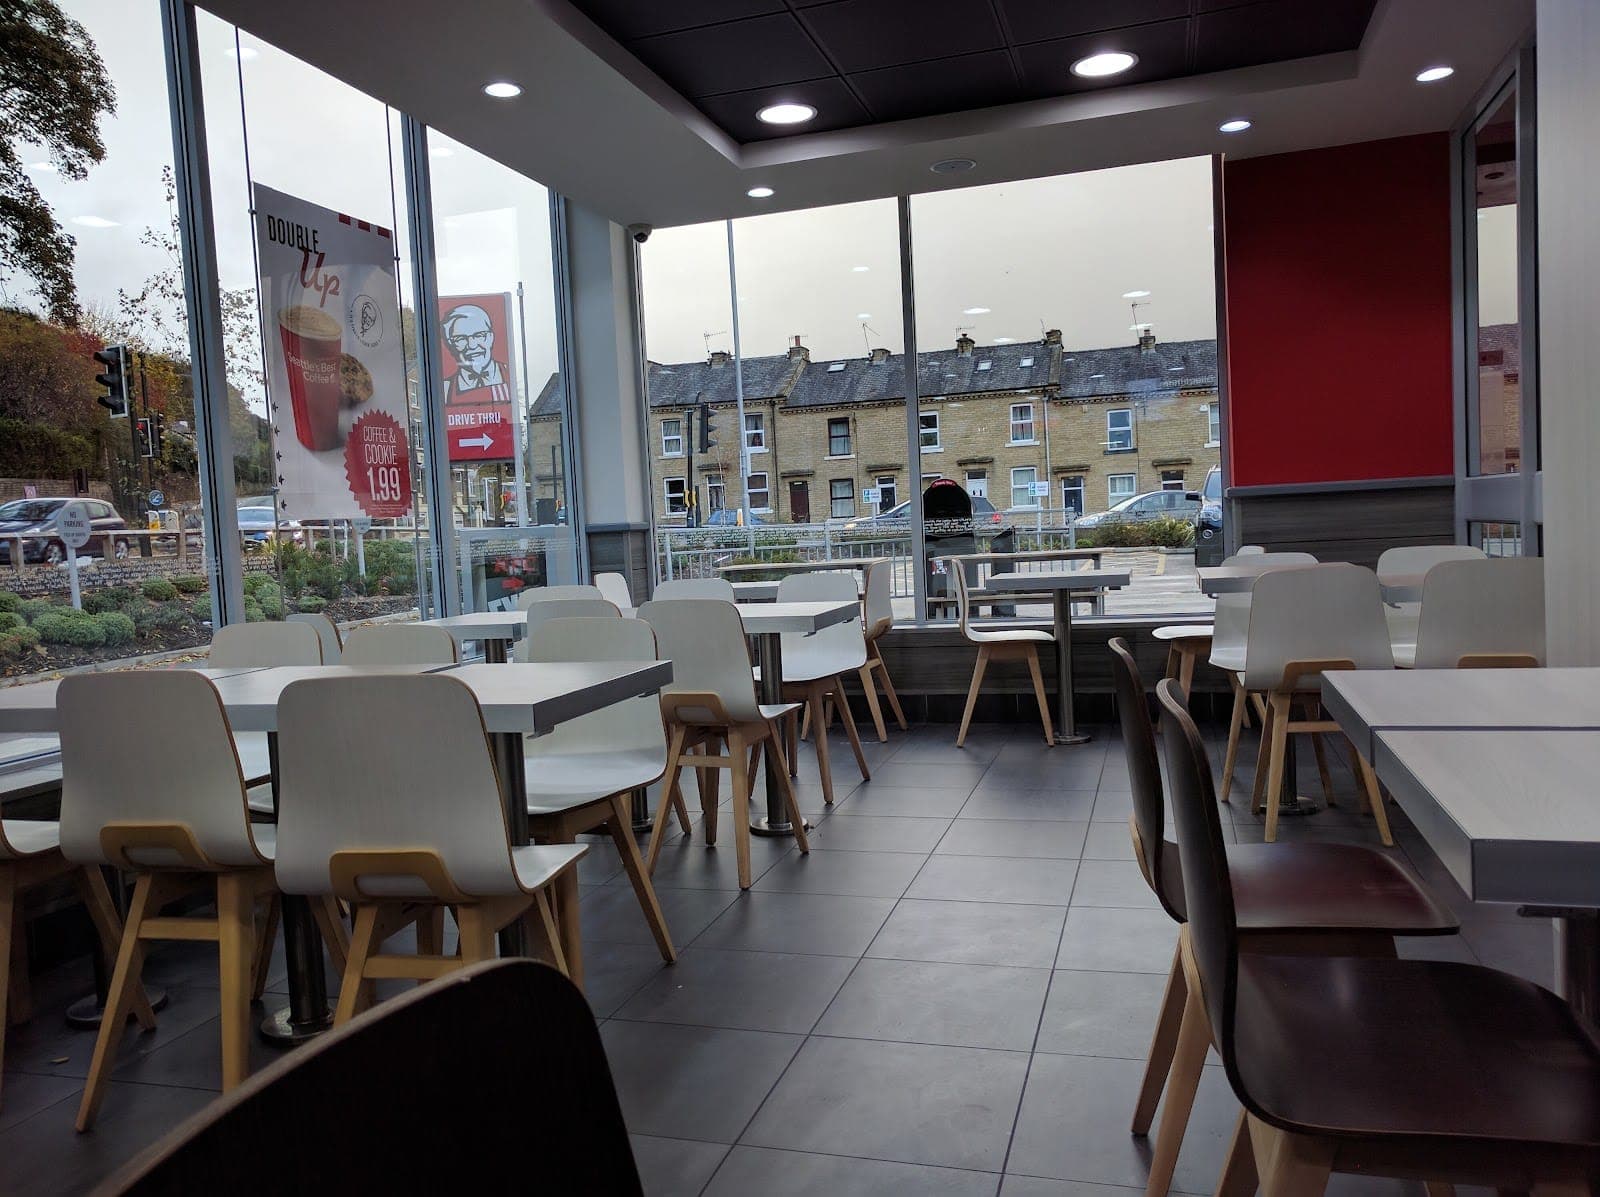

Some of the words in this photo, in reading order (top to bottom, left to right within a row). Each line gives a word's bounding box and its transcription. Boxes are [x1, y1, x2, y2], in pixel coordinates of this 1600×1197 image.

[267, 214, 320, 255] DOUBLE
[297, 247, 340, 308] Up
[303, 371, 330, 384] Coffee
[321, 362, 337, 373] Best
[448, 413, 476, 426] DRIVE
[476, 411, 501, 425] THRU
[363, 425, 388, 443] COFFEE
[389, 427, 397, 443] &
[364, 443, 398, 465] COOKIE
[366, 466, 401, 501] 1.99
